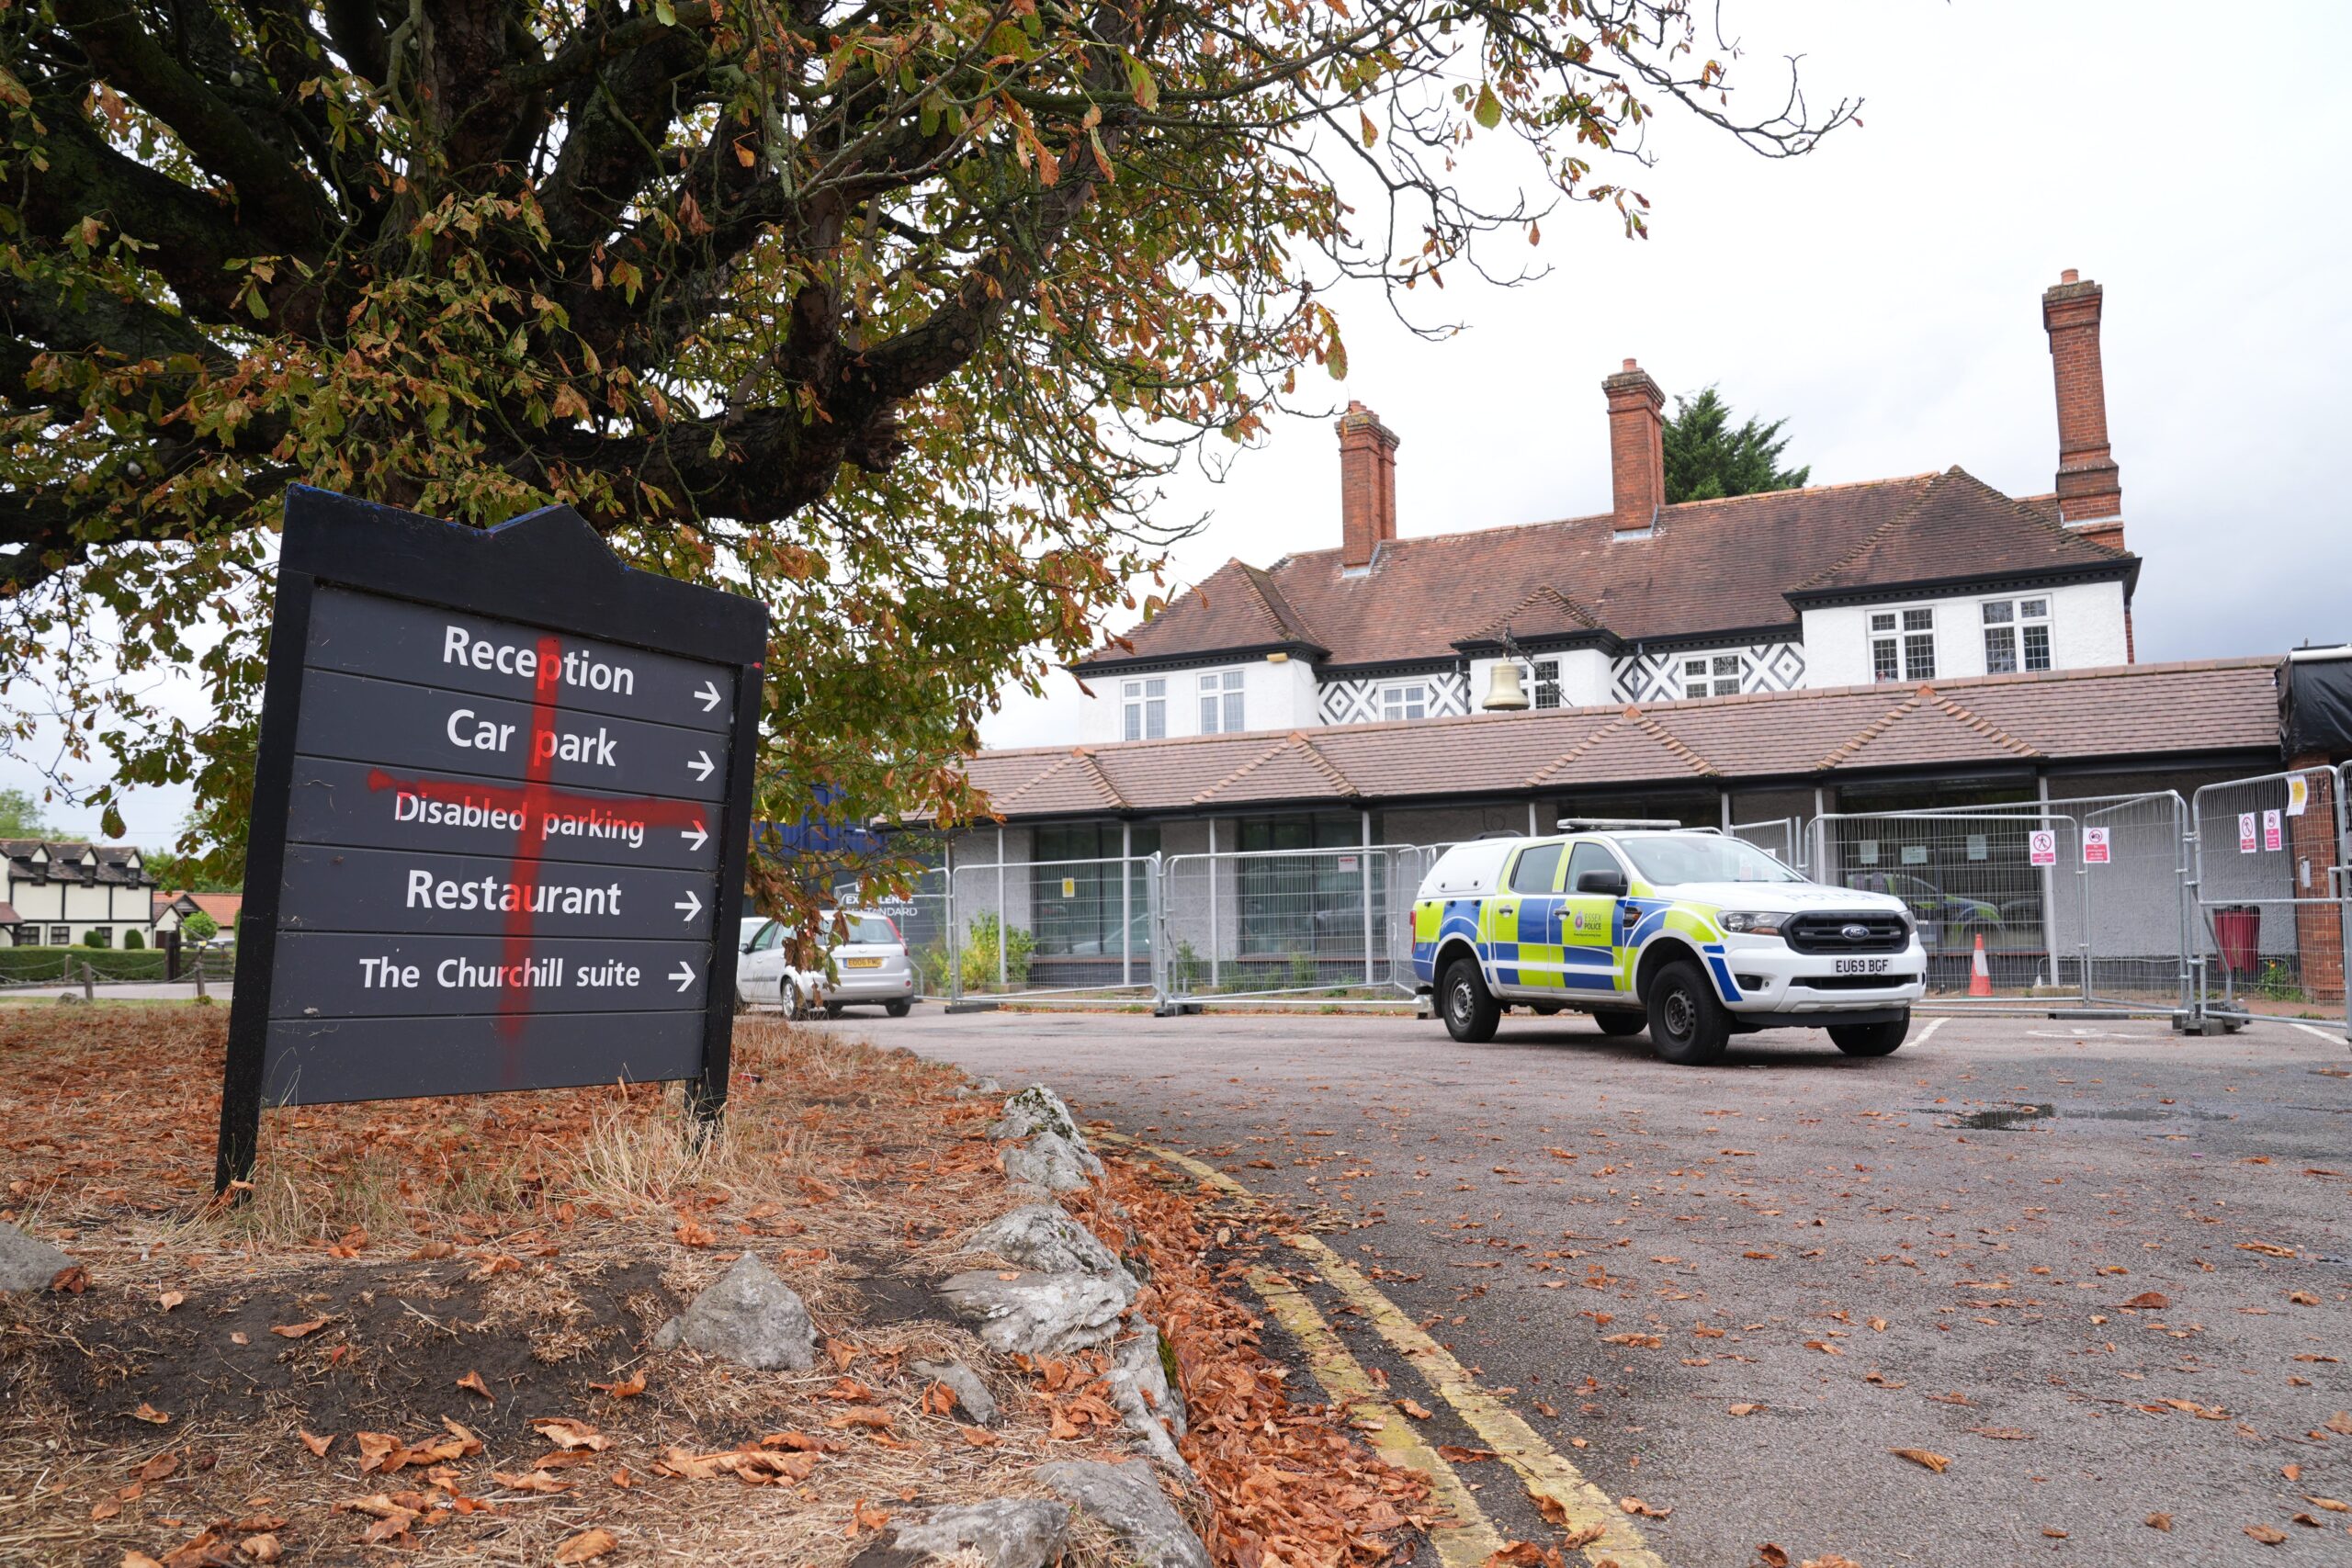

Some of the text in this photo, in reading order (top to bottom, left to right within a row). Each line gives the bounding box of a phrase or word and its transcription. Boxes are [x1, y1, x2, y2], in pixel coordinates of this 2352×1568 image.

[443, 625, 635, 696] Reception
[447, 708, 617, 768] Car park
[394, 791, 644, 849] Disabled parking
[406, 869, 623, 917] Restaurant
[1584, 922, 1601, 931] POLICE
[359, 956, 640, 989] The Churchill suite
[1836, 959, 1889, 973] EU69 BGF
